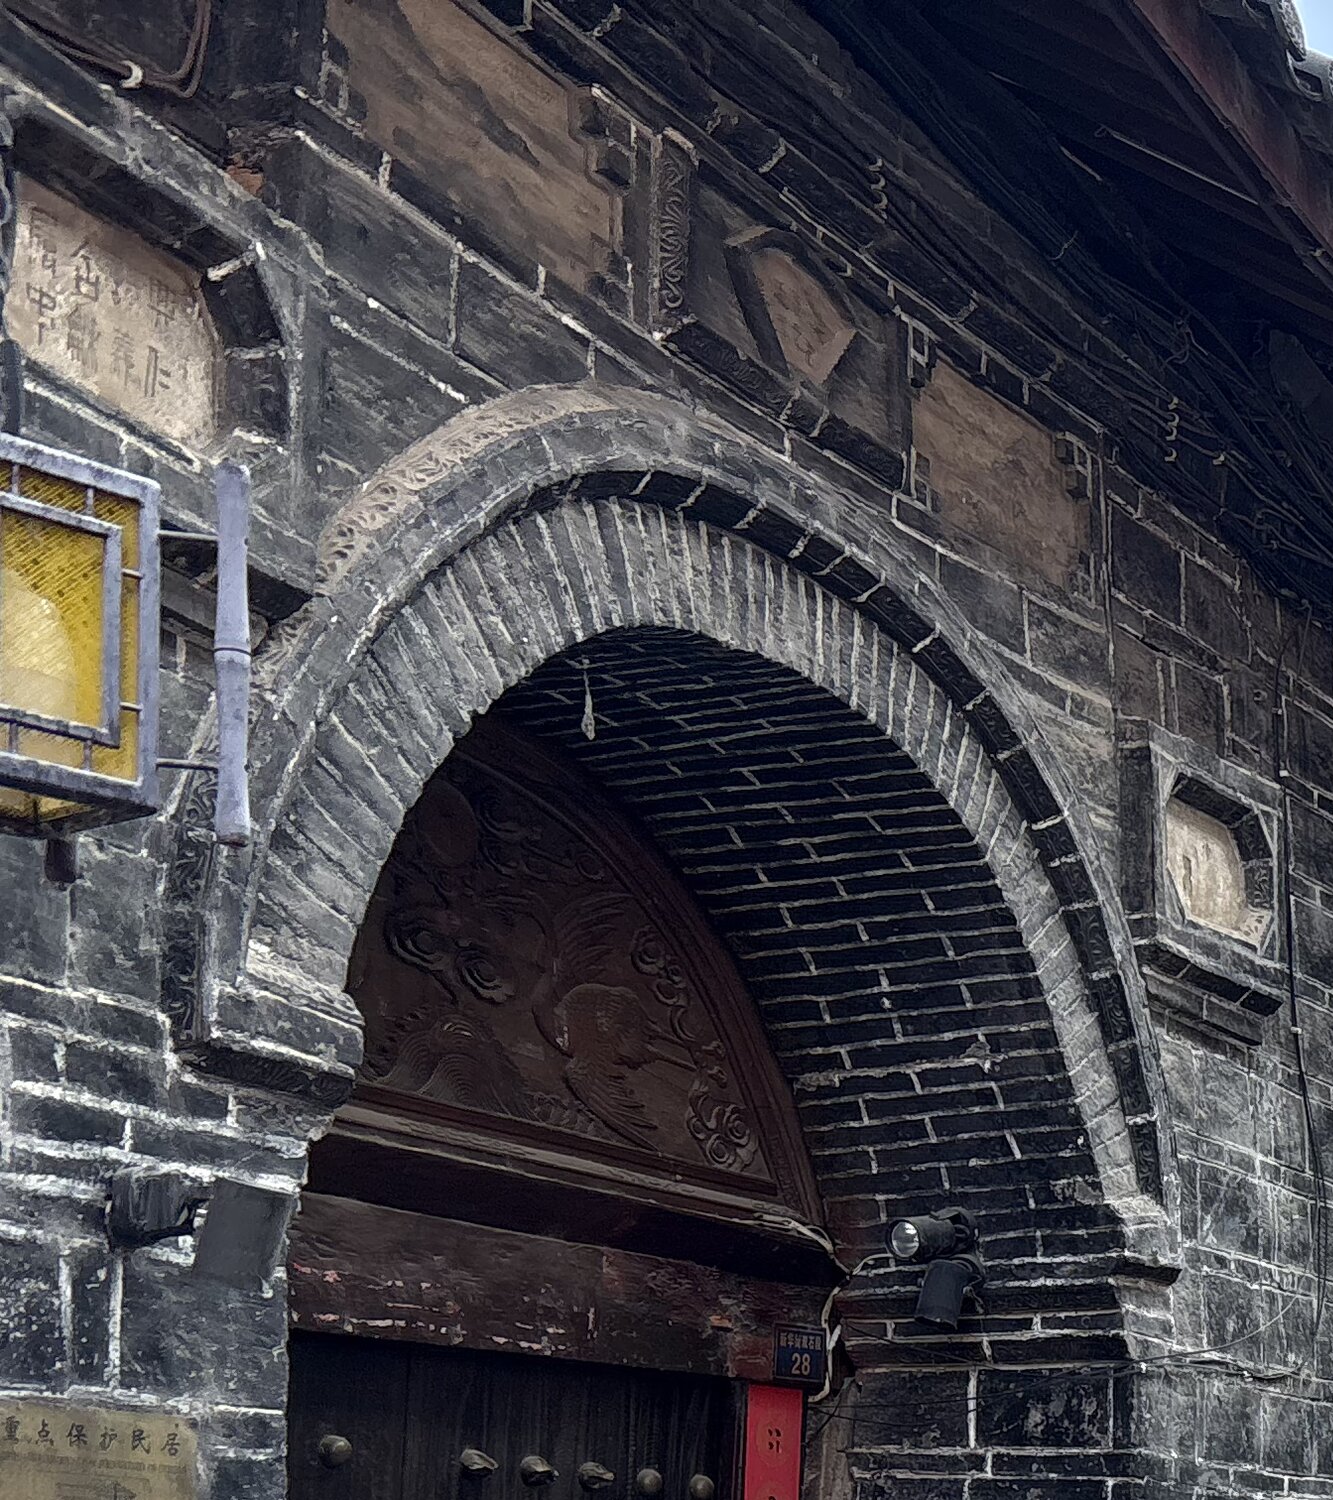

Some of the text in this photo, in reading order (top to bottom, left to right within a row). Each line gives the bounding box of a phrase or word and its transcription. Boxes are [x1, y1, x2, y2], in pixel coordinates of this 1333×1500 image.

[791, 1352, 811, 1376] 28
[1, 1416, 182, 1457] 重点保护民居
